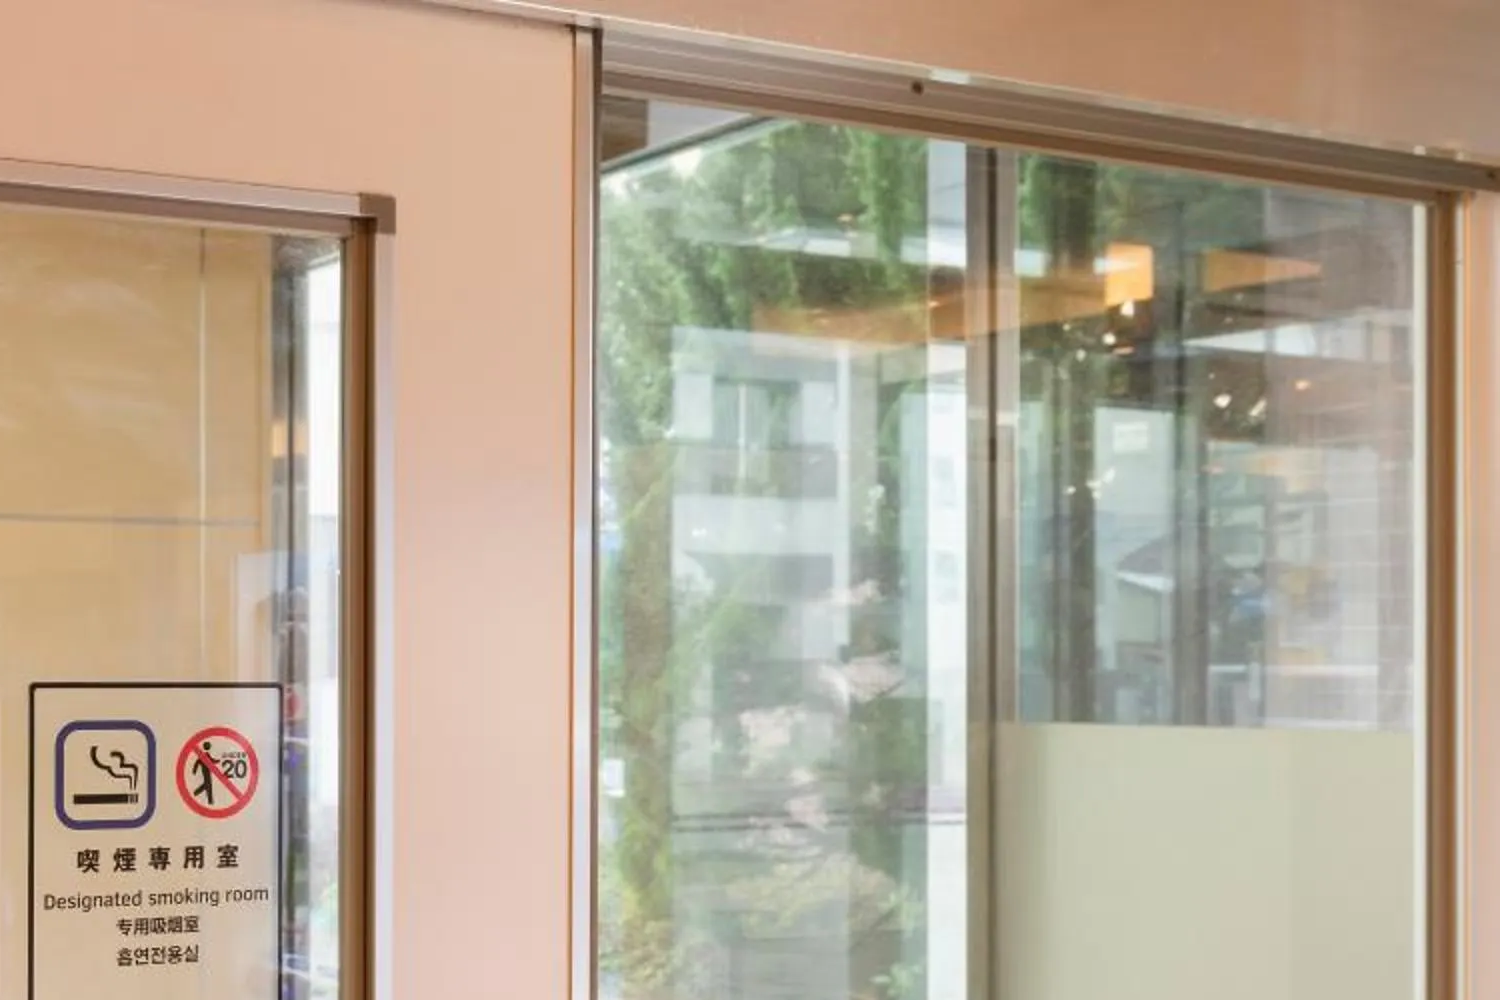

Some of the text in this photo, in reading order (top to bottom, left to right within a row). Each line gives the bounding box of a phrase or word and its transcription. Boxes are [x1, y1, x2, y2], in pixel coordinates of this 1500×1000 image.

[221, 759, 247, 779] 20
[76, 844, 240, 874] 喫煙専用室
[43, 887, 270, 913] Designated smoking room
[116, 915, 201, 937] 专用吸烟室
[116, 944, 200, 967] 흡연전용실
